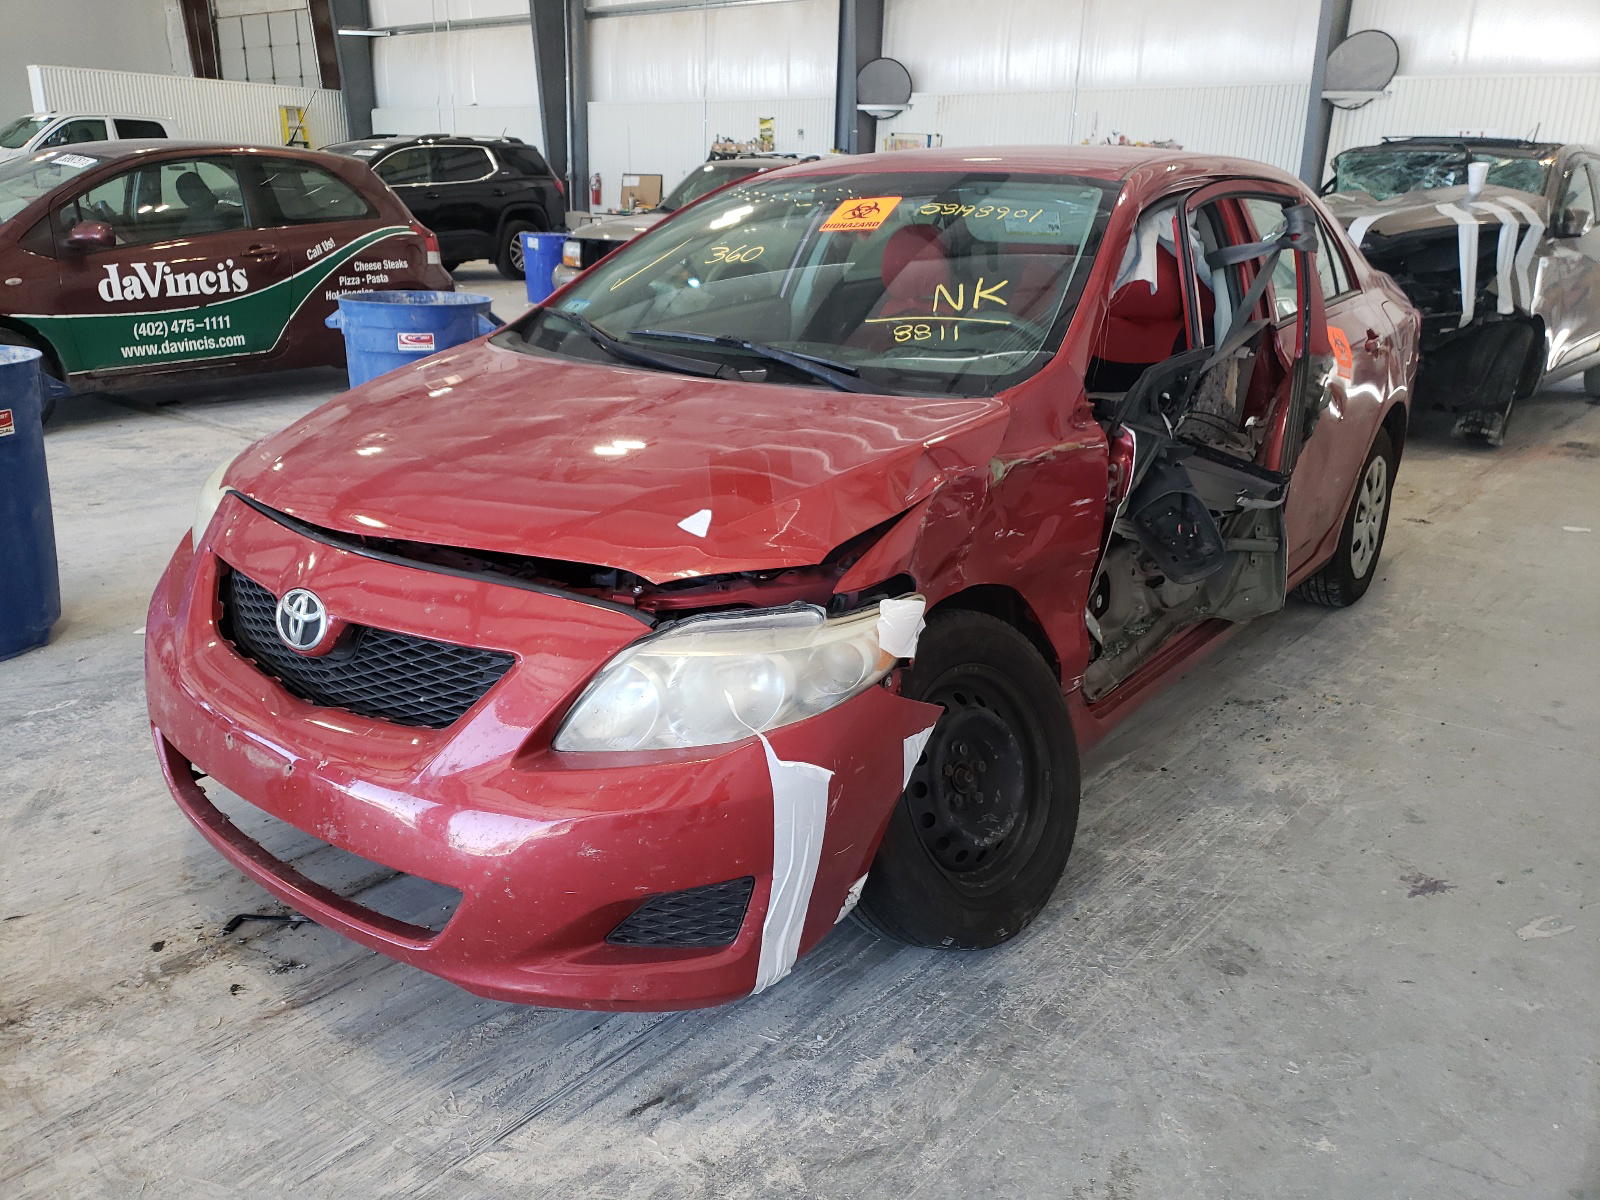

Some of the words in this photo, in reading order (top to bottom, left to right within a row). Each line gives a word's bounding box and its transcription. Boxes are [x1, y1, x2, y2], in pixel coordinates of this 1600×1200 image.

[822, 221, 881, 229] BIOHAZARD
[306, 244, 322, 260] Call
[321, 237, 336, 252] Us!
[704, 244, 764, 264] 360
[354, 261, 382, 272] Cheese
[383, 259, 409, 270] Steaks
[98, 259, 249, 302] daVinci's
[339, 275, 360, 286] Pizza
[366, 273, 389, 284] Pasta
[133, 321, 168, 340] (402)
[170, 315, 231, 333] 475-1111
[120, 334, 246, 358] www.davincis.com
